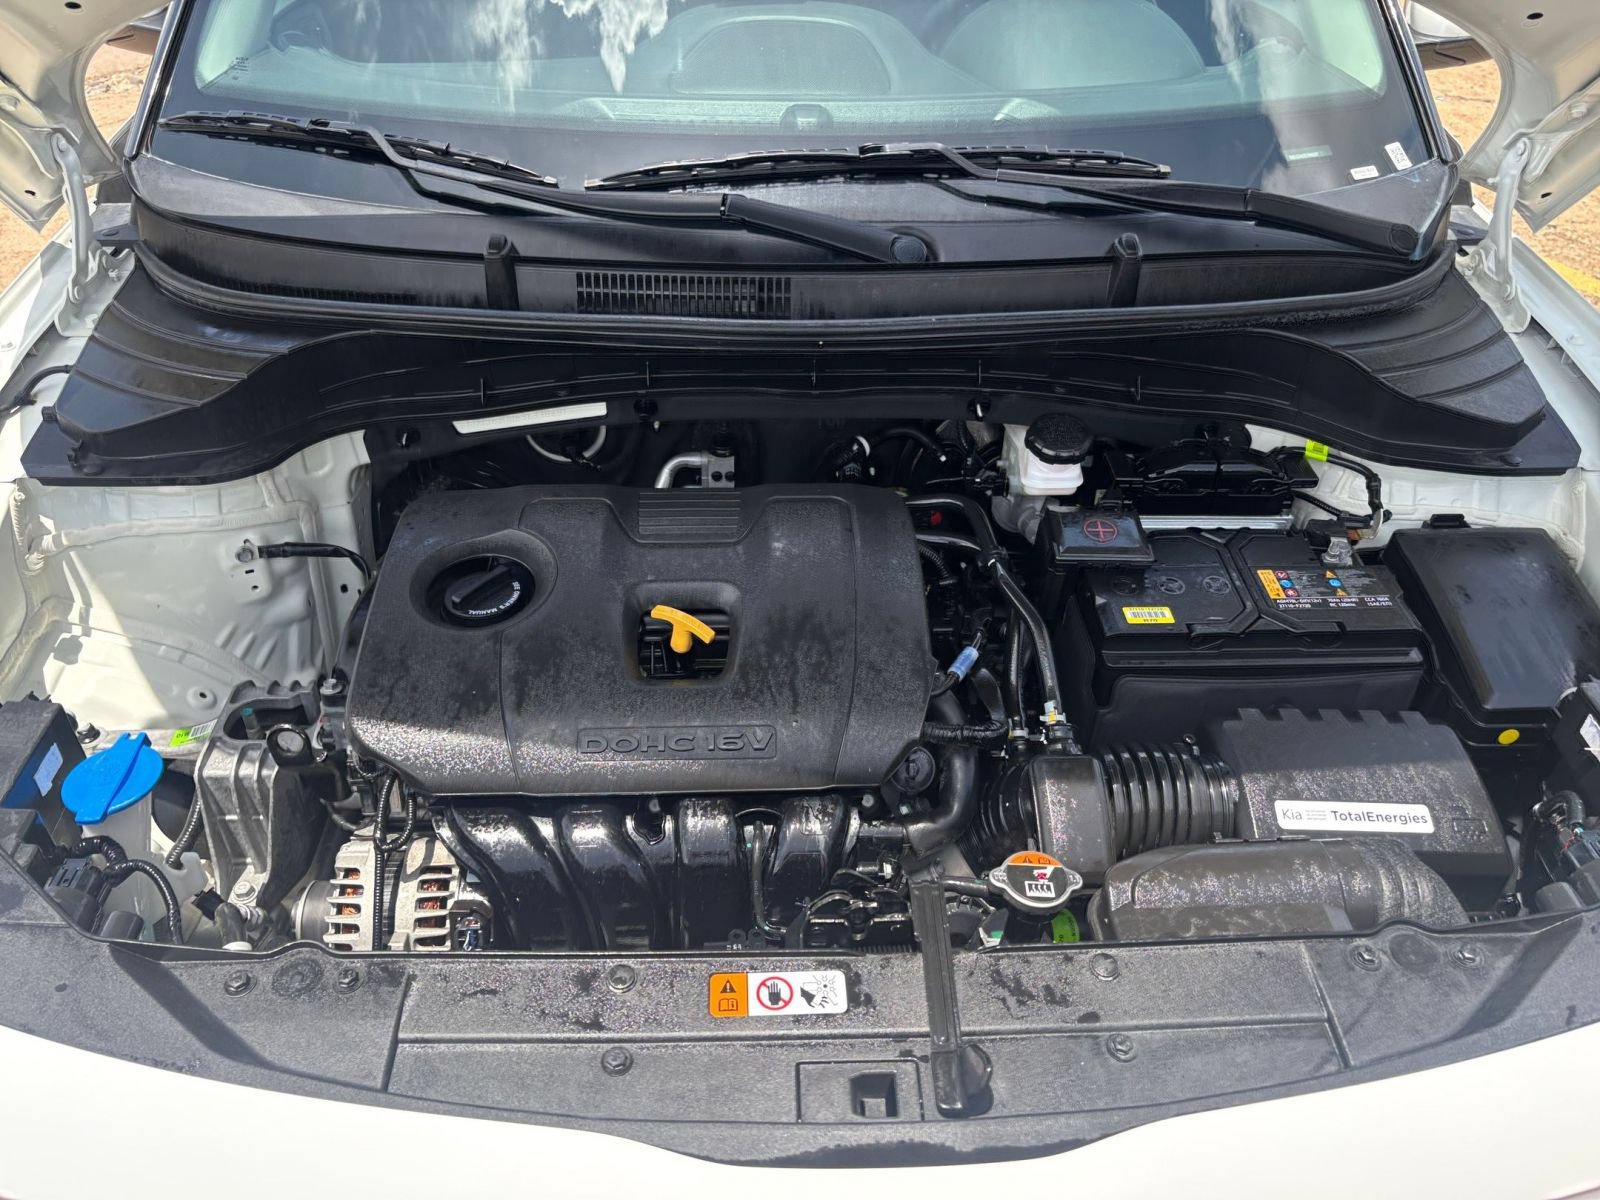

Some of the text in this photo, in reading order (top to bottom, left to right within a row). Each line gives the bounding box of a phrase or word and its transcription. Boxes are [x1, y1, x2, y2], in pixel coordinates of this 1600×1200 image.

[580, 732, 774, 754] DOHC 16V
[1281, 808, 1303, 821] Kia
[1330, 810, 1428, 826] TotalEnergies
